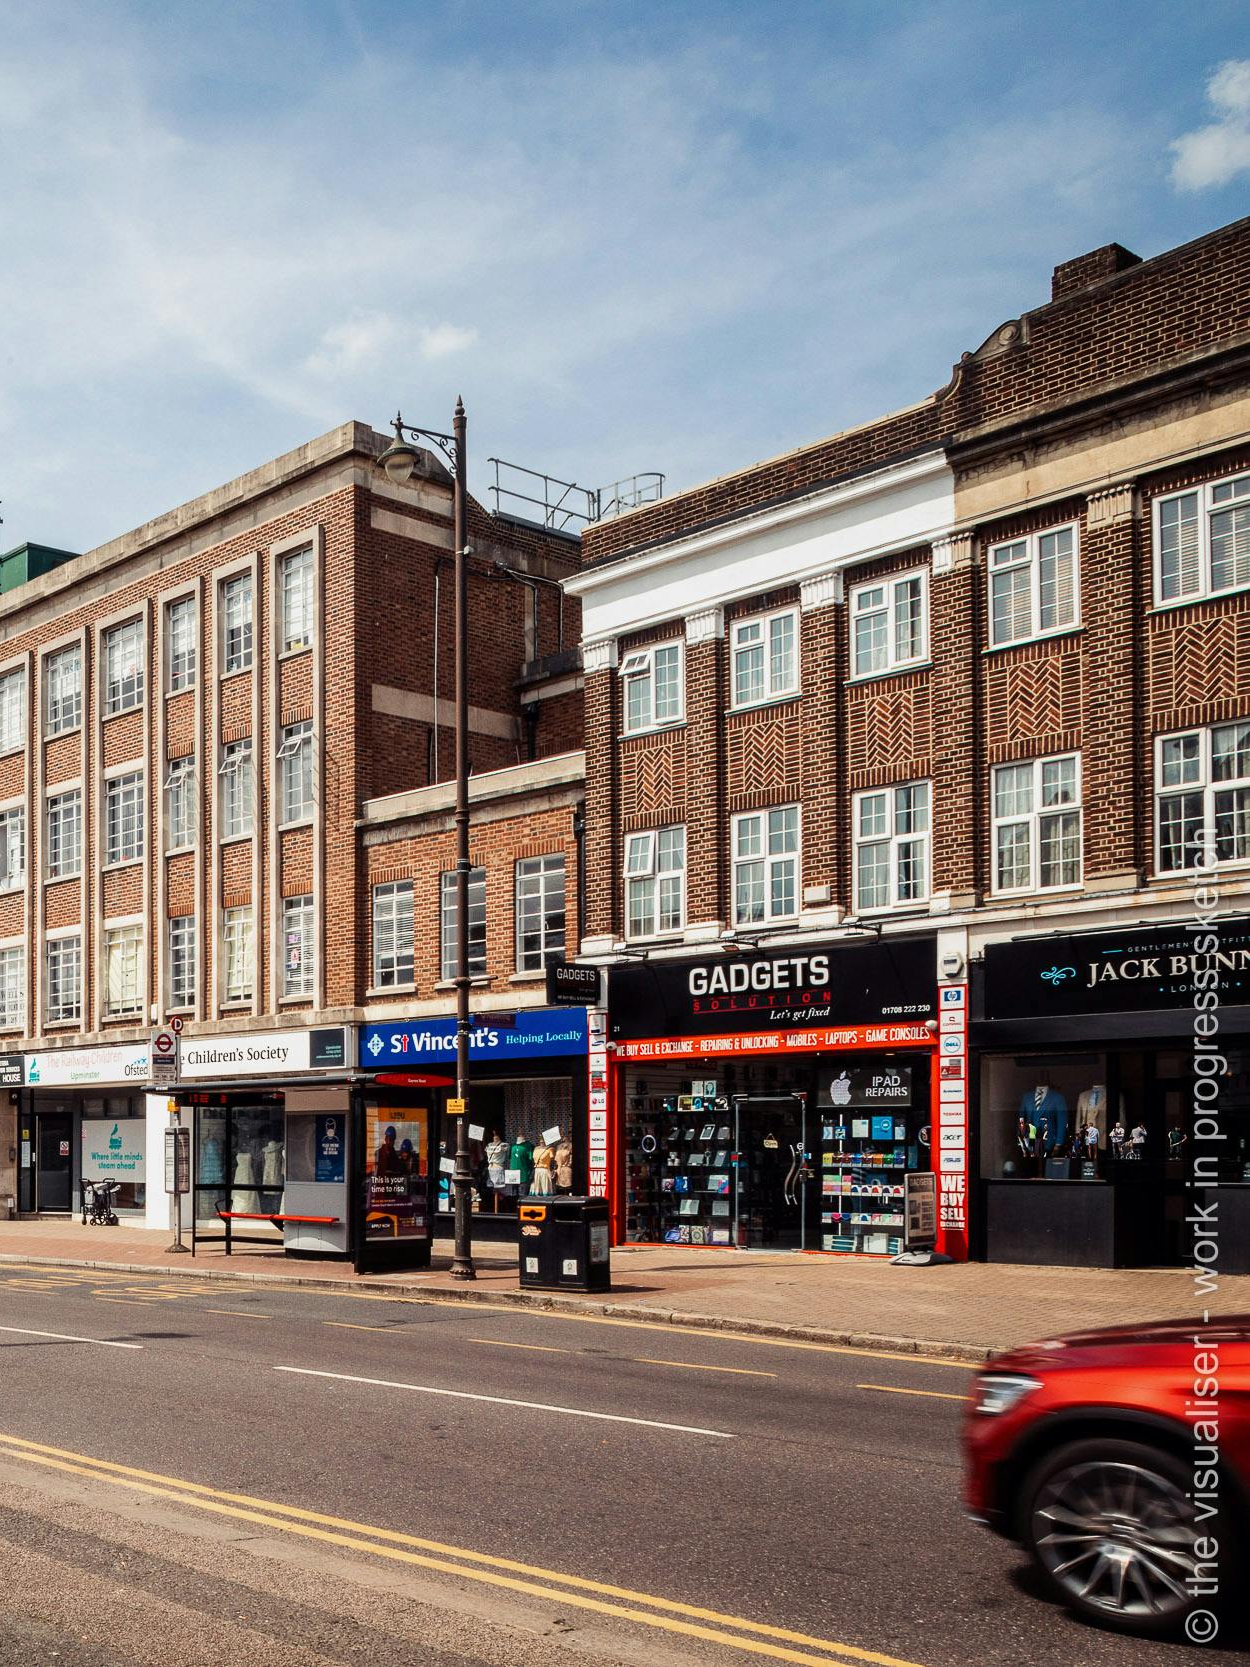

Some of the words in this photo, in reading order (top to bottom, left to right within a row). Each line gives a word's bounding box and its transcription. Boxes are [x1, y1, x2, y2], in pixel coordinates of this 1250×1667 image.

[556, 968, 596, 982] GADGETS
[689, 955, 829, 995] GADGETS
[1087, 957, 1162, 988] JACK
[693, 991, 831, 1012] SOLUTION
[903, 1005, 916, 1013] 222
[917, 1004, 930, 1012] 230
[769, 1009, 791, 1020] Let's
[793, 1008, 806, 1021] get
[806, 1006, 831, 1021] fixed
[174, 1018, 182, 1030] D
[390, 1034, 409, 1053] St
[506, 1033, 544, 1045] Helping
[546, 1030, 583, 1041] Locally
[626, 1044, 639, 1056] BUY
[640, 1043, 654, 1055] SELL
[655, 1043, 660, 1054] &
[661, 1041, 694, 1054] EXCHANGE
[700, 1038, 733, 1052] REPAIRING
[734, 1038, 740, 1050] &
[741, 1035, 779, 1050] UNLOCKING
[786, 1033, 818, 1047] MOBILES
[825, 1031, 858, 1045] LAPTOPS
[865, 1029, 888, 1042] GAME
[889, 1026, 930, 1041] CONSOLES
[46, 1055, 60, 1067] The
[61, 1053, 90, 1069] Railway
[92, 1050, 124, 1065] Children
[187, 1047, 244, 1065] Children's
[247, 1046, 289, 1062] Society
[2, 1073, 21, 1083] HOUSE
[70, 1072, 100, 1080] Upminster
[872, 1075, 901, 1087] IPAD
[865, 1087, 908, 1097] REPAIRS
[91, 1152, 109, 1160] Where
[110, 1152, 123, 1160] little
[124, 1152, 143, 1160] minds
[116, 1161, 136, 1169] ahead
[371, 1175, 383, 1184] This
[384, 1175, 390, 1184] is
[390, 1177, 405, 1185] your
[590, 1170, 606, 1185] WE
[940, 1175, 965, 1192] WE
[371, 1184, 385, 1193] time
[386, 1185, 392, 1193] to
[393, 1184, 405, 1193] rise
[590, 1185, 606, 1197] BUY
[940, 1192, 965, 1207] BUY
[940, 1207, 965, 1221] SELL
